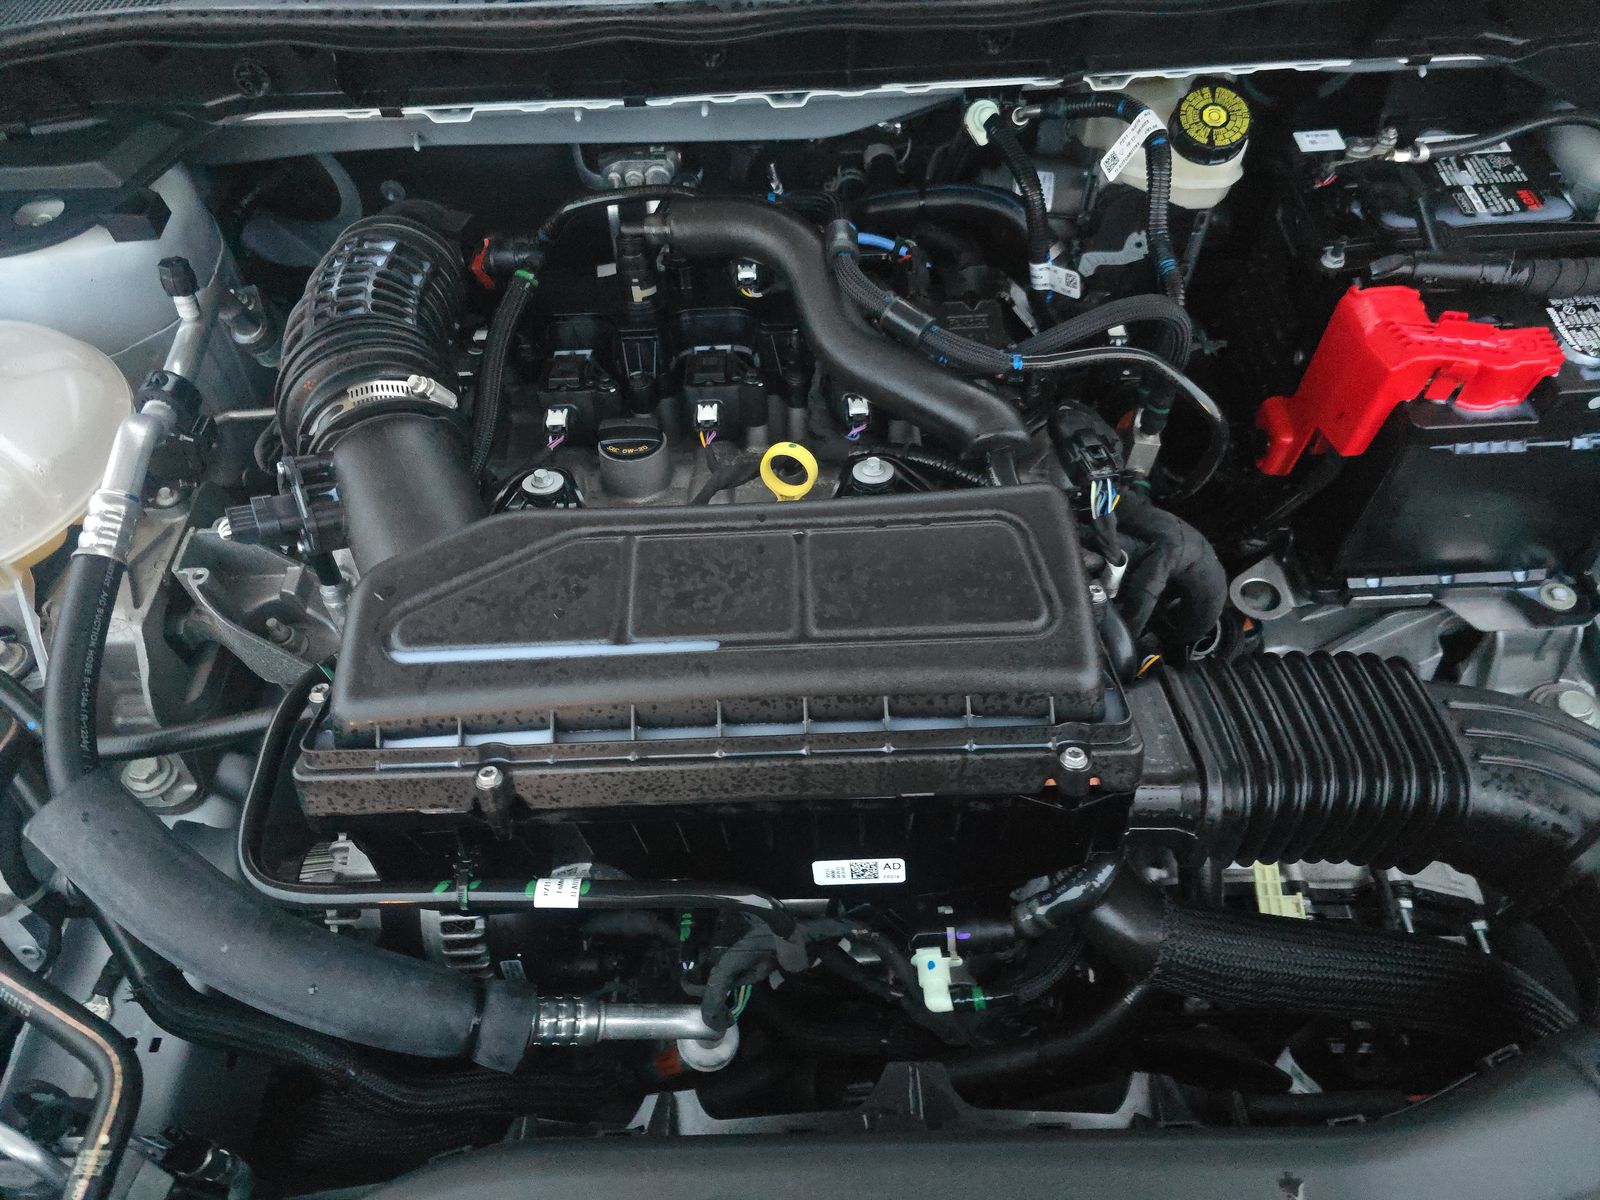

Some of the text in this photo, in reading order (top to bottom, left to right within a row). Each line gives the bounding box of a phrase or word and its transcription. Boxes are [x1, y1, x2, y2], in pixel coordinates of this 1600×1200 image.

[90, 607, 104, 648] SUCTION
[84, 649, 96, 675] HOSE
[883, 862, 902, 871] AD
